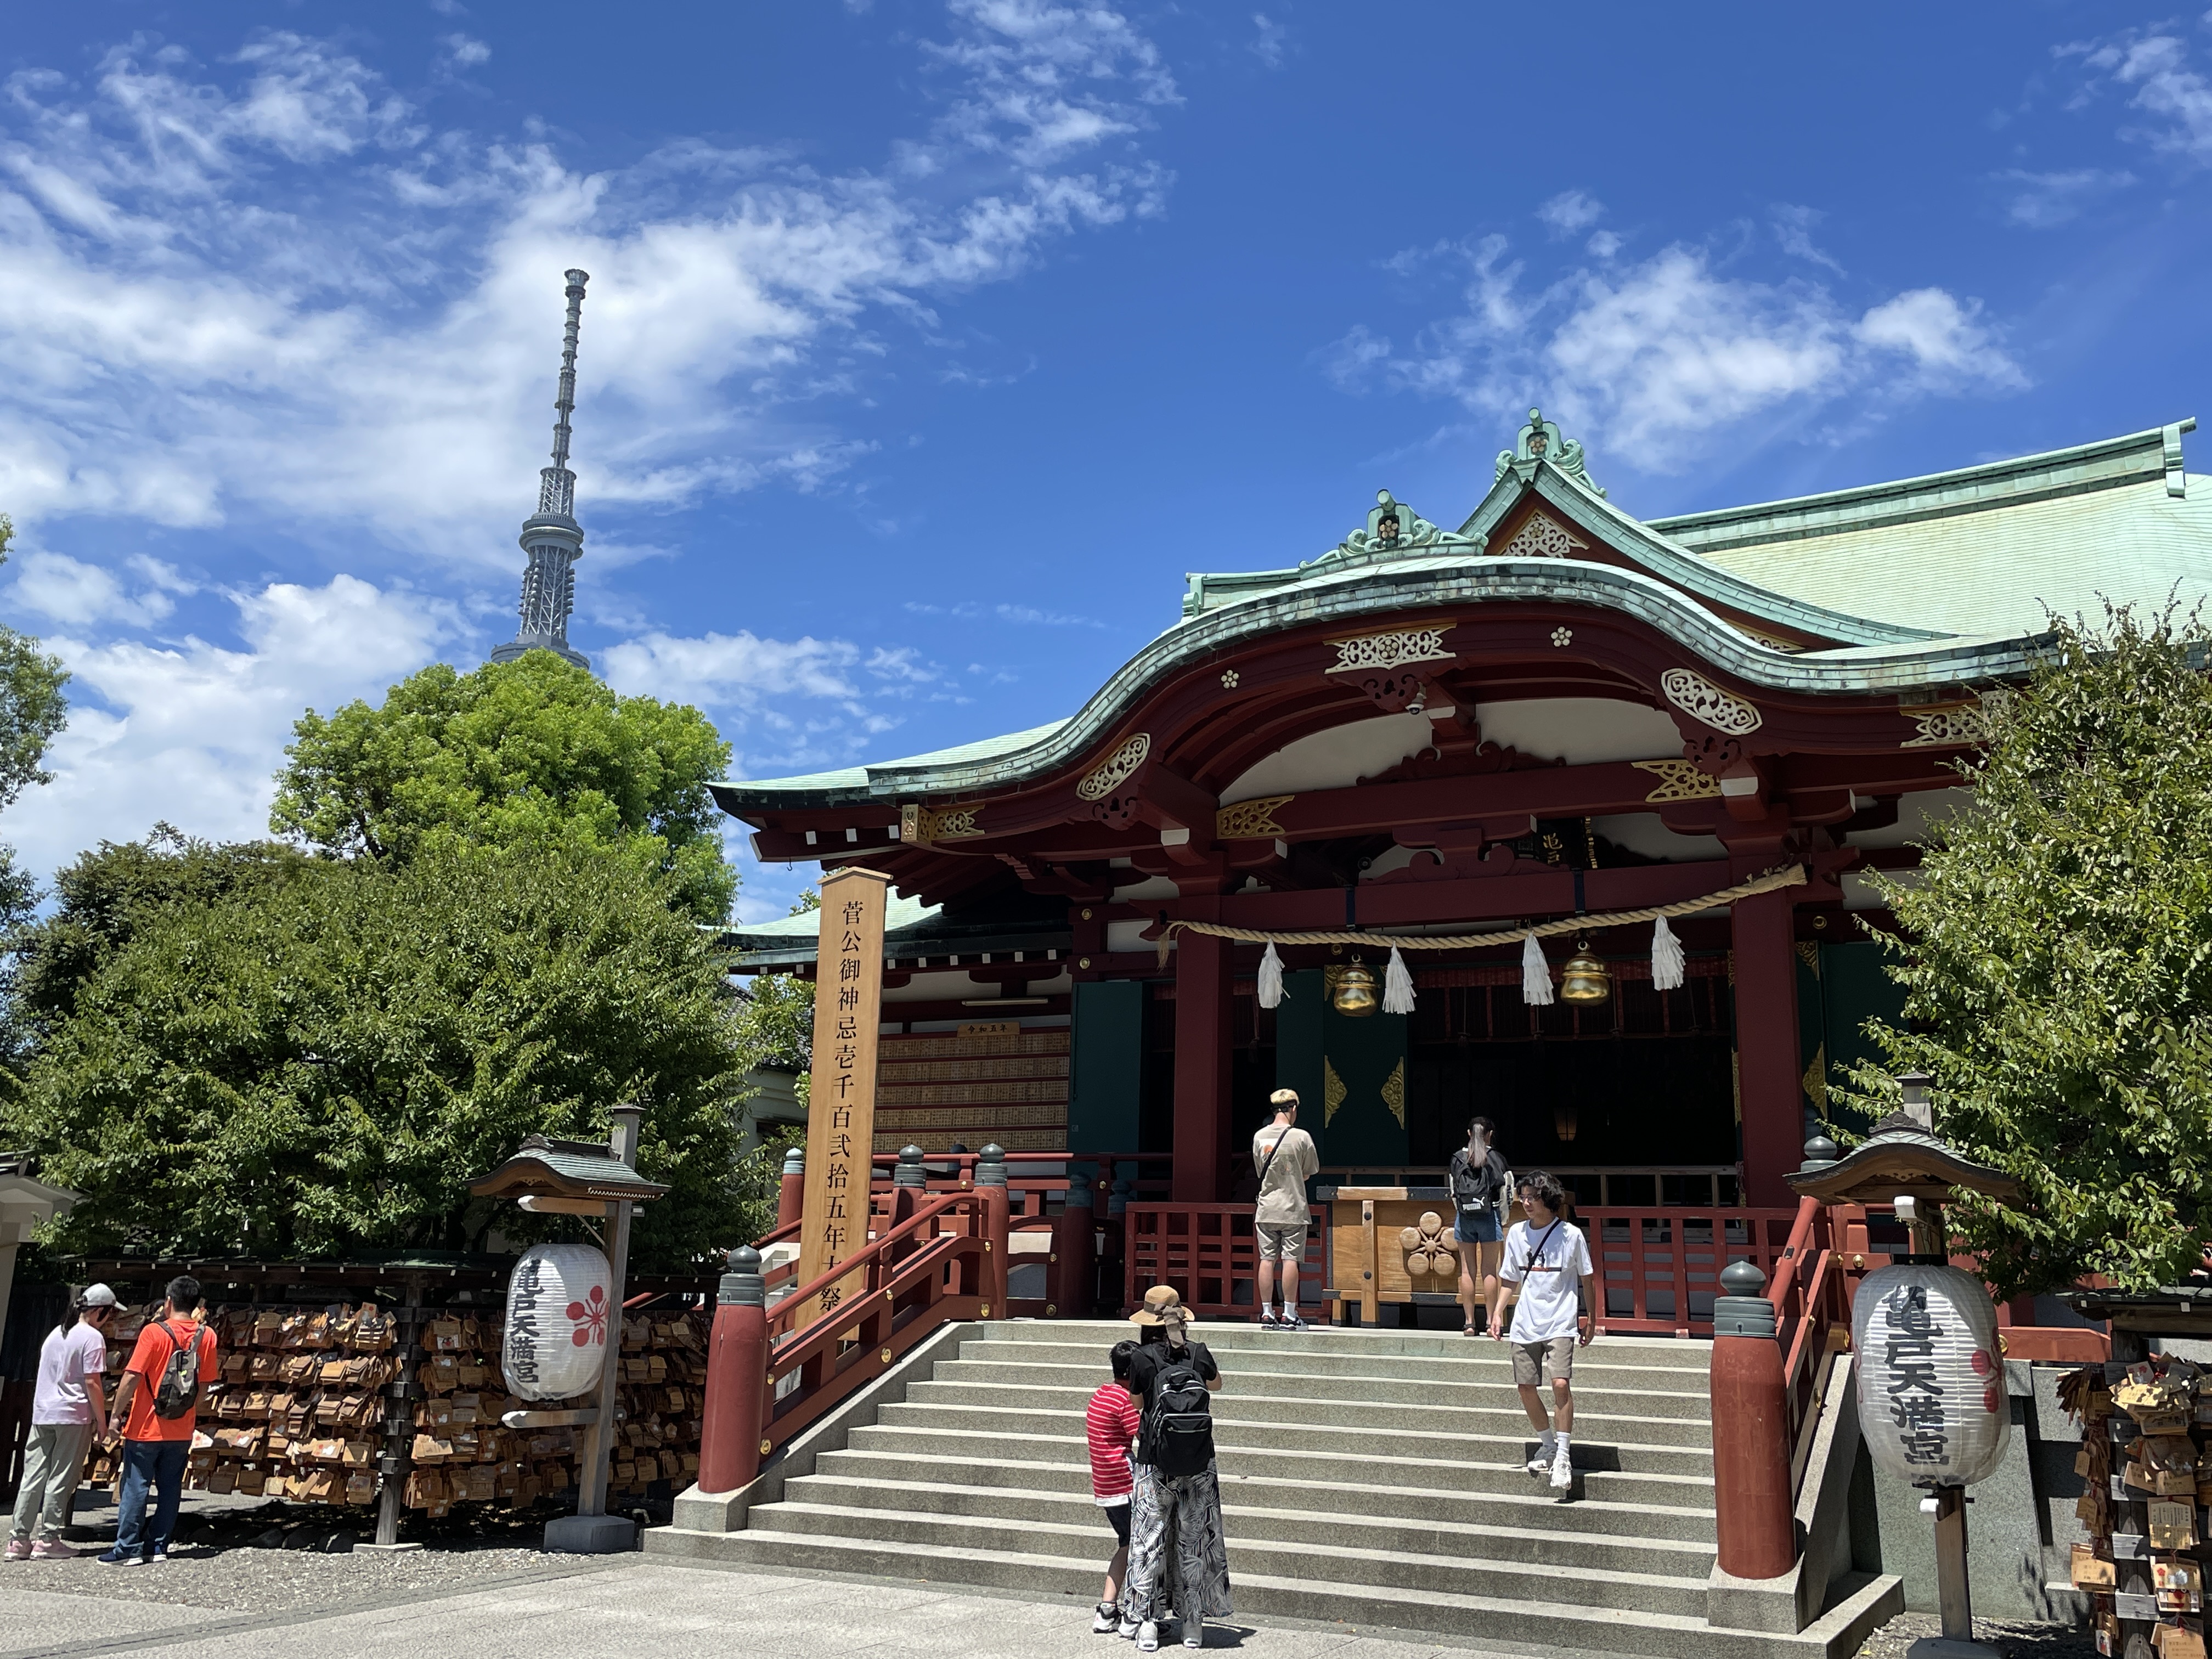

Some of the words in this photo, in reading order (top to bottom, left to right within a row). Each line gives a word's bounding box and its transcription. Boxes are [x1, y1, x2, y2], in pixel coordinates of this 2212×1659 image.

[967, 1023, 1007, 1035] 令和五年
[510, 1258, 545, 1384] 亀戸天満宮
[1881, 1284, 1950, 1465] 亀戸天満宮
